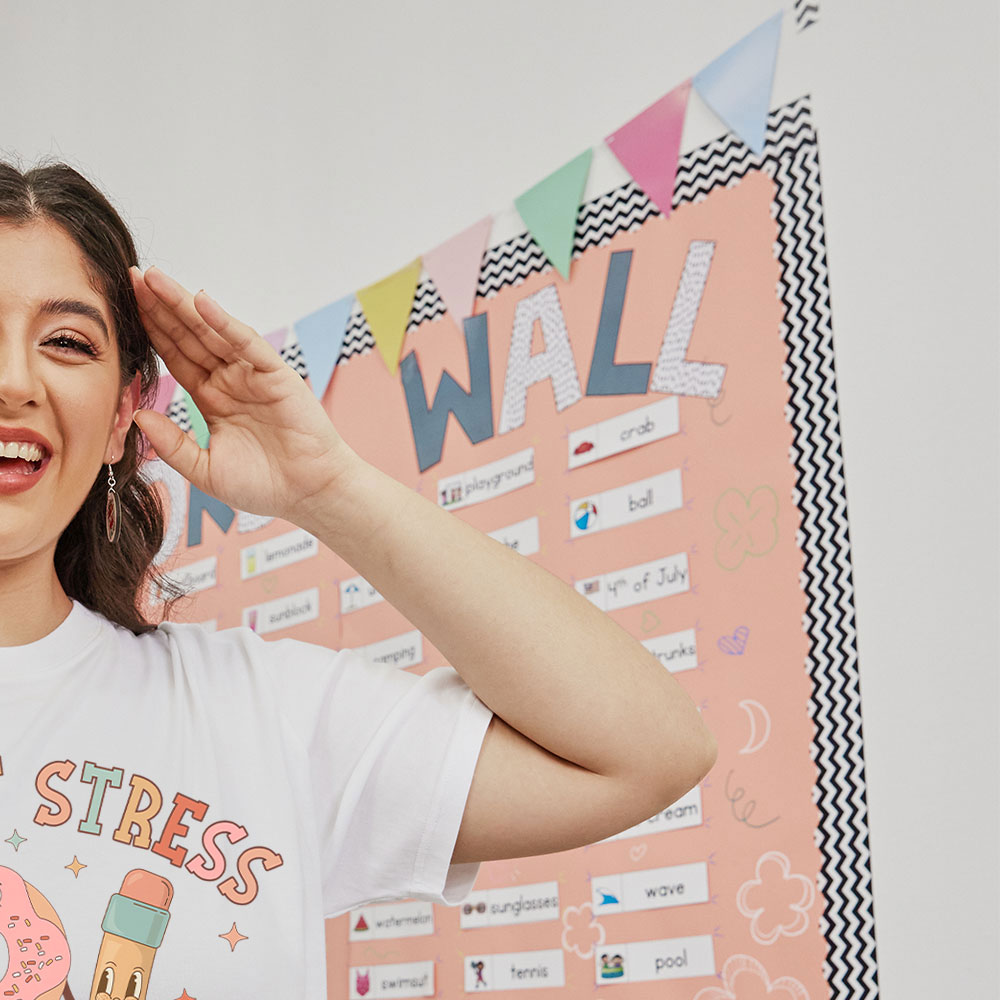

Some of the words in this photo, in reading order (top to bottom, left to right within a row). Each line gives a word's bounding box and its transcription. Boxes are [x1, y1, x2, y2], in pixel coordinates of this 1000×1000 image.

[399, 239, 727, 474] WALL
[620, 415, 655, 442] crab
[465, 454, 534, 497] playground
[628, 489, 655, 513] ball
[633, 571, 650, 592] of
[656, 565, 688, 587] July
[33, 760, 284, 905] STRESS
[645, 882, 686, 901] wave
[490, 894, 559, 918] sunglasses
[510, 963, 550, 981] tennis
[654, 948, 689, 974] pool
